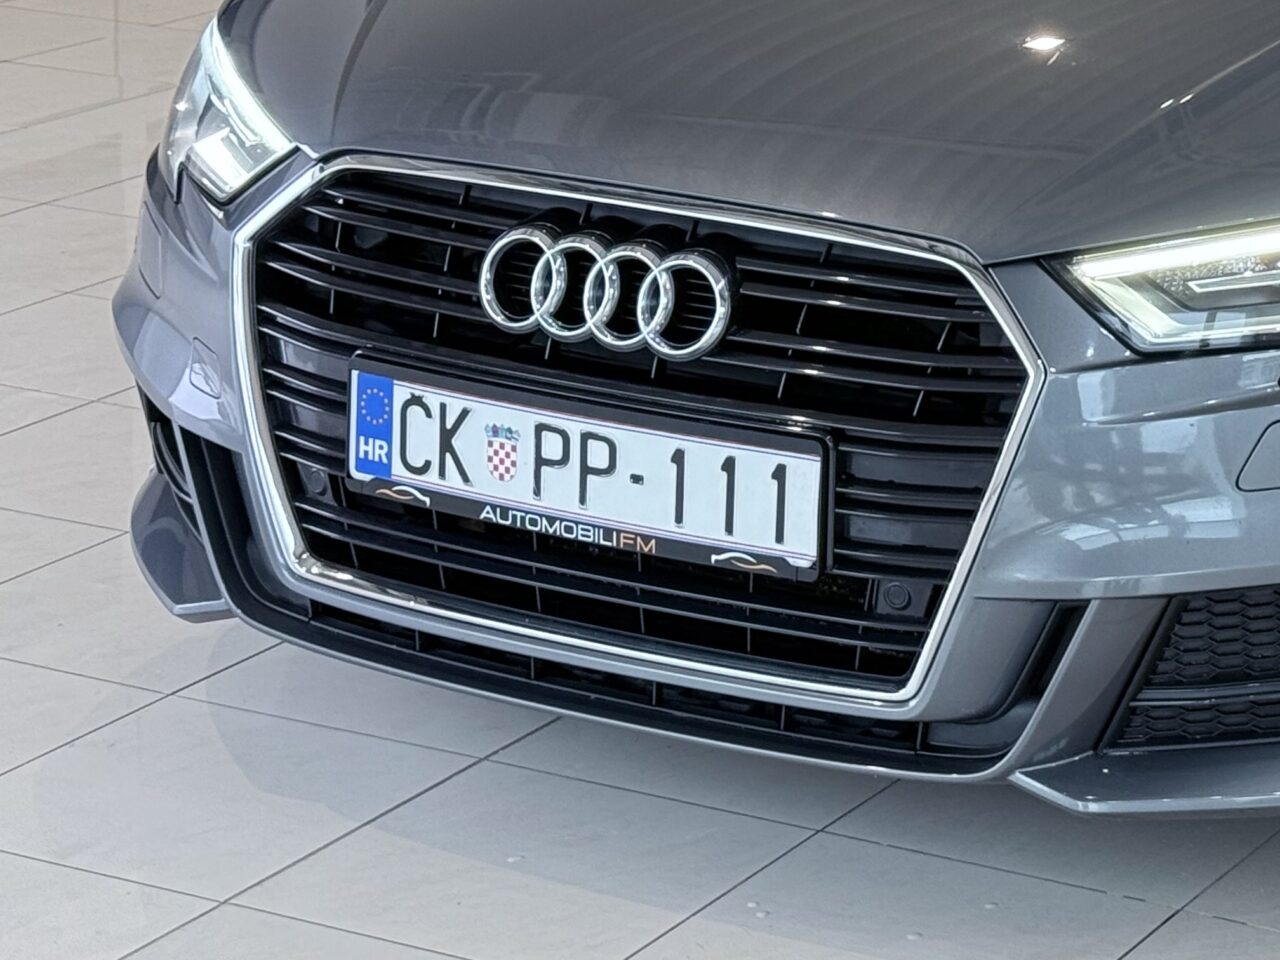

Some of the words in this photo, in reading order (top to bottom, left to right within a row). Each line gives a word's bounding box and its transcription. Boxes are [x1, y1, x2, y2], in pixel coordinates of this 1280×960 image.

[359, 436, 388, 464] HR
[400, 392, 472, 486] ČK
[533, 422, 787, 545] PP-111
[479, 505, 656, 554] AUTOMOBILIFM
